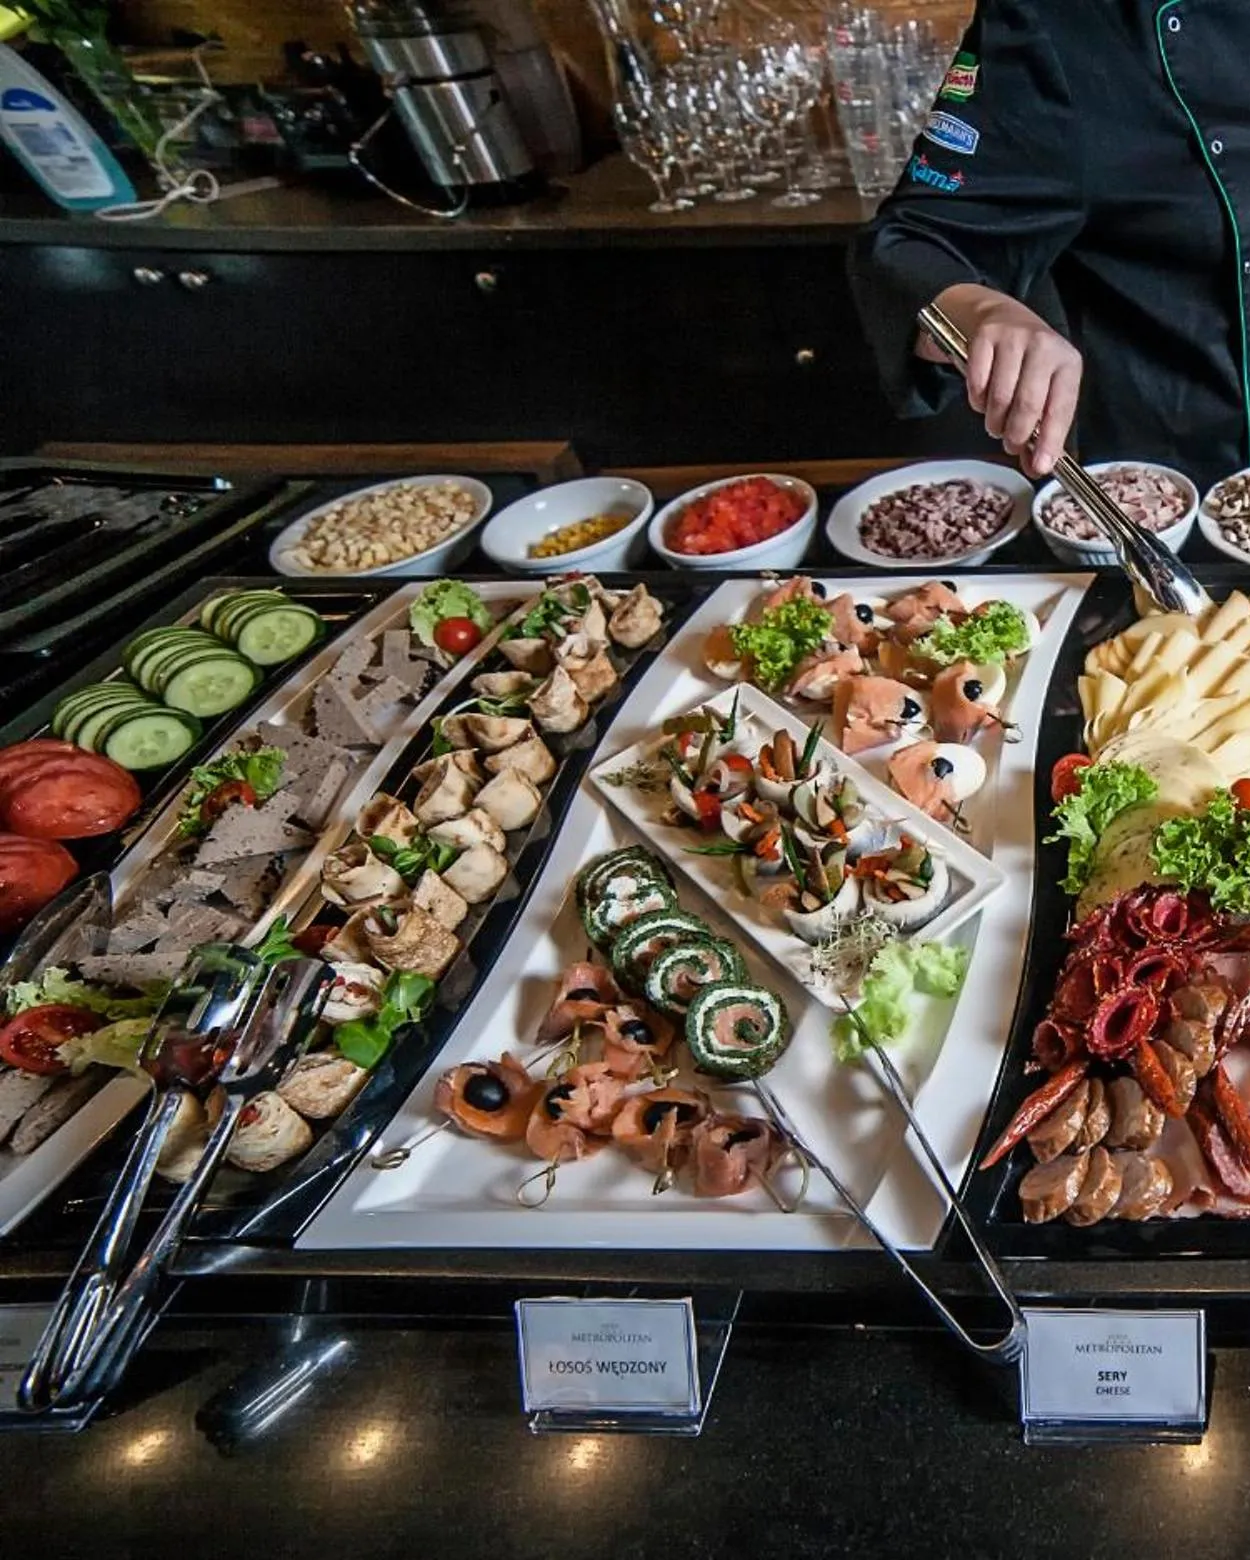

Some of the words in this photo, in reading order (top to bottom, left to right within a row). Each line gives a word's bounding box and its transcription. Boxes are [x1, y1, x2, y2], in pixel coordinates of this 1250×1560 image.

[1074, 1343, 1163, 1354] METROPOLITAN
[549, 1359, 593, 1375] ŁOSOŚ
[597, 1360, 667, 1377] WĘDZONY
[1097, 1370, 1128, 1382] SERY
[1095, 1385, 1132, 1396] CHEESE
